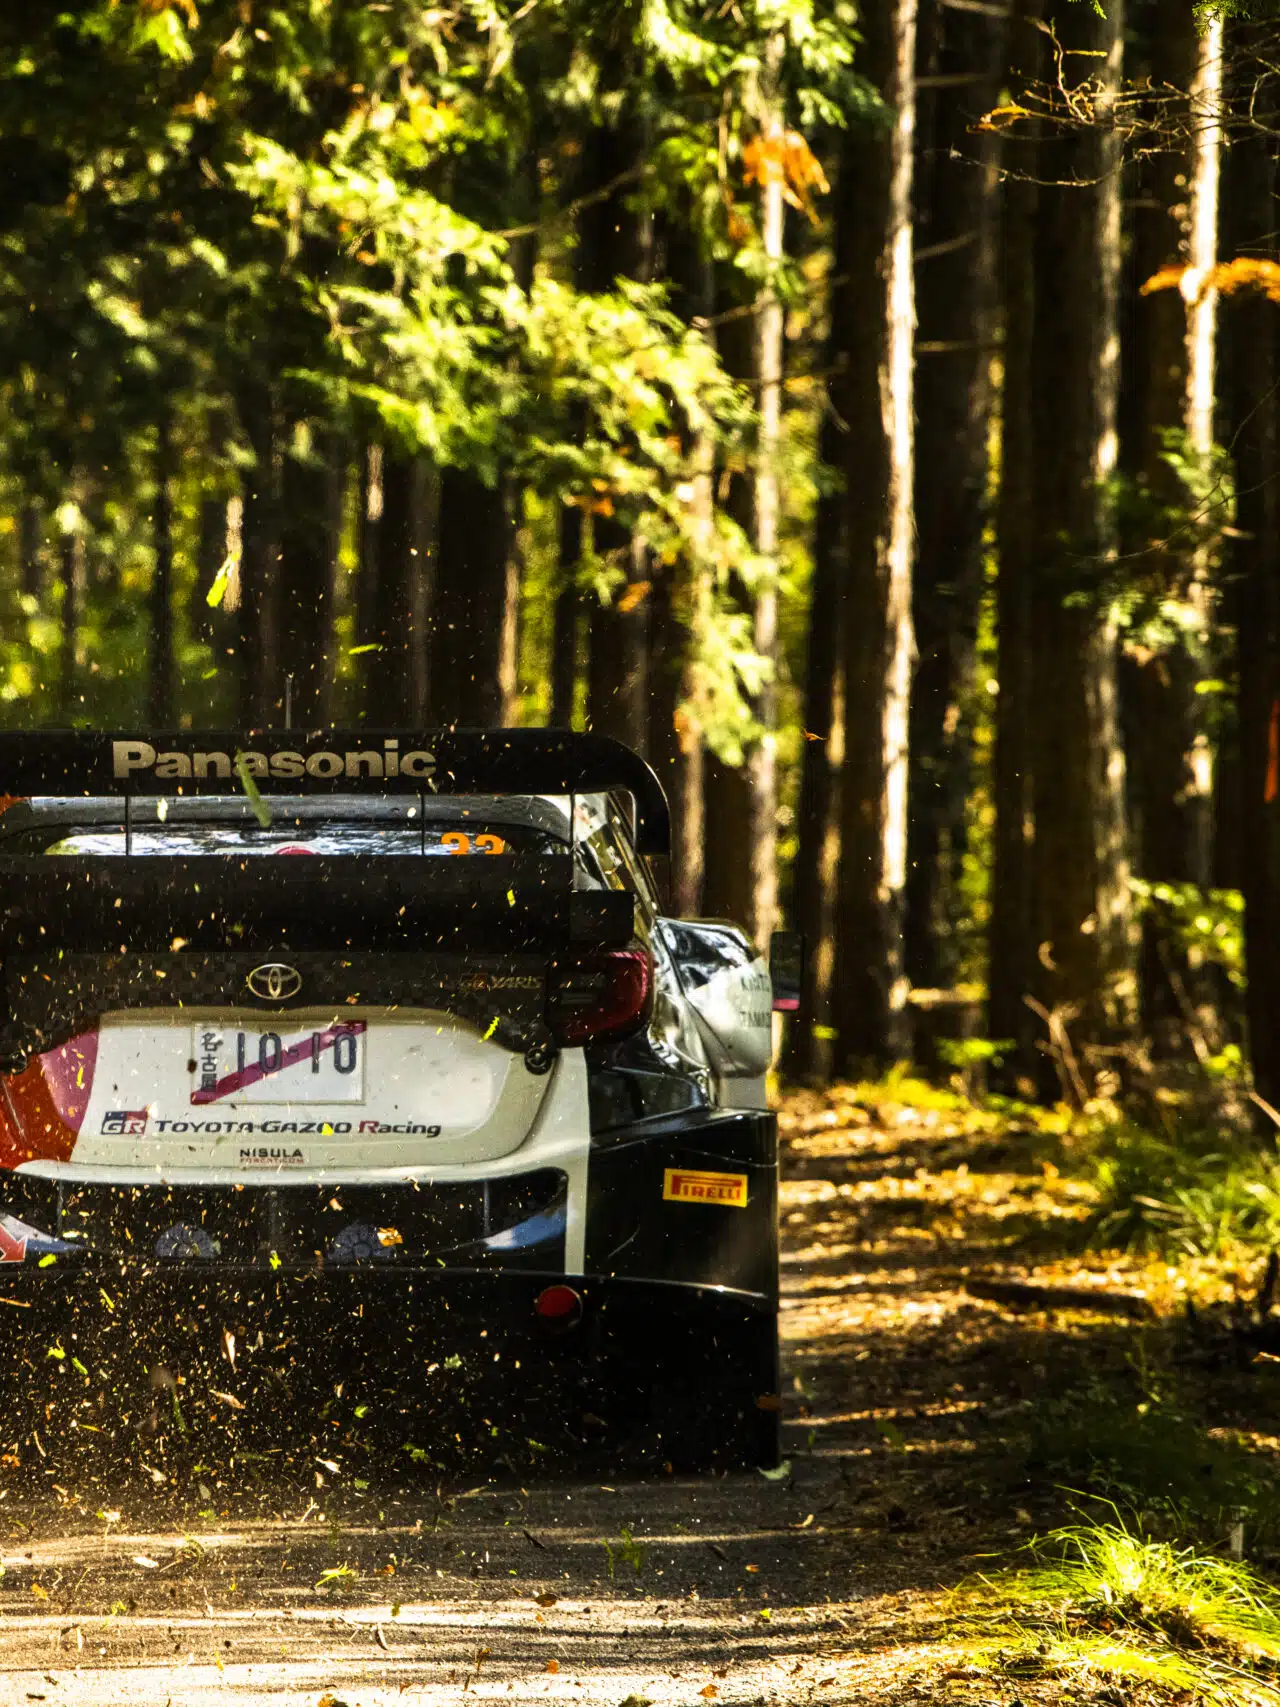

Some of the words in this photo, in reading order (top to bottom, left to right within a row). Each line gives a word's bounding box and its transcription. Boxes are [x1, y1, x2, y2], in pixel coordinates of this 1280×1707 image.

[113, 739, 436, 779] Panasonic
[237, 1032, 357, 1074] 10-10
[358, 1120, 442, 1138] Racing
[240, 1148, 303, 1157] NISULA
[671, 1174, 742, 1200] PIRELLI
